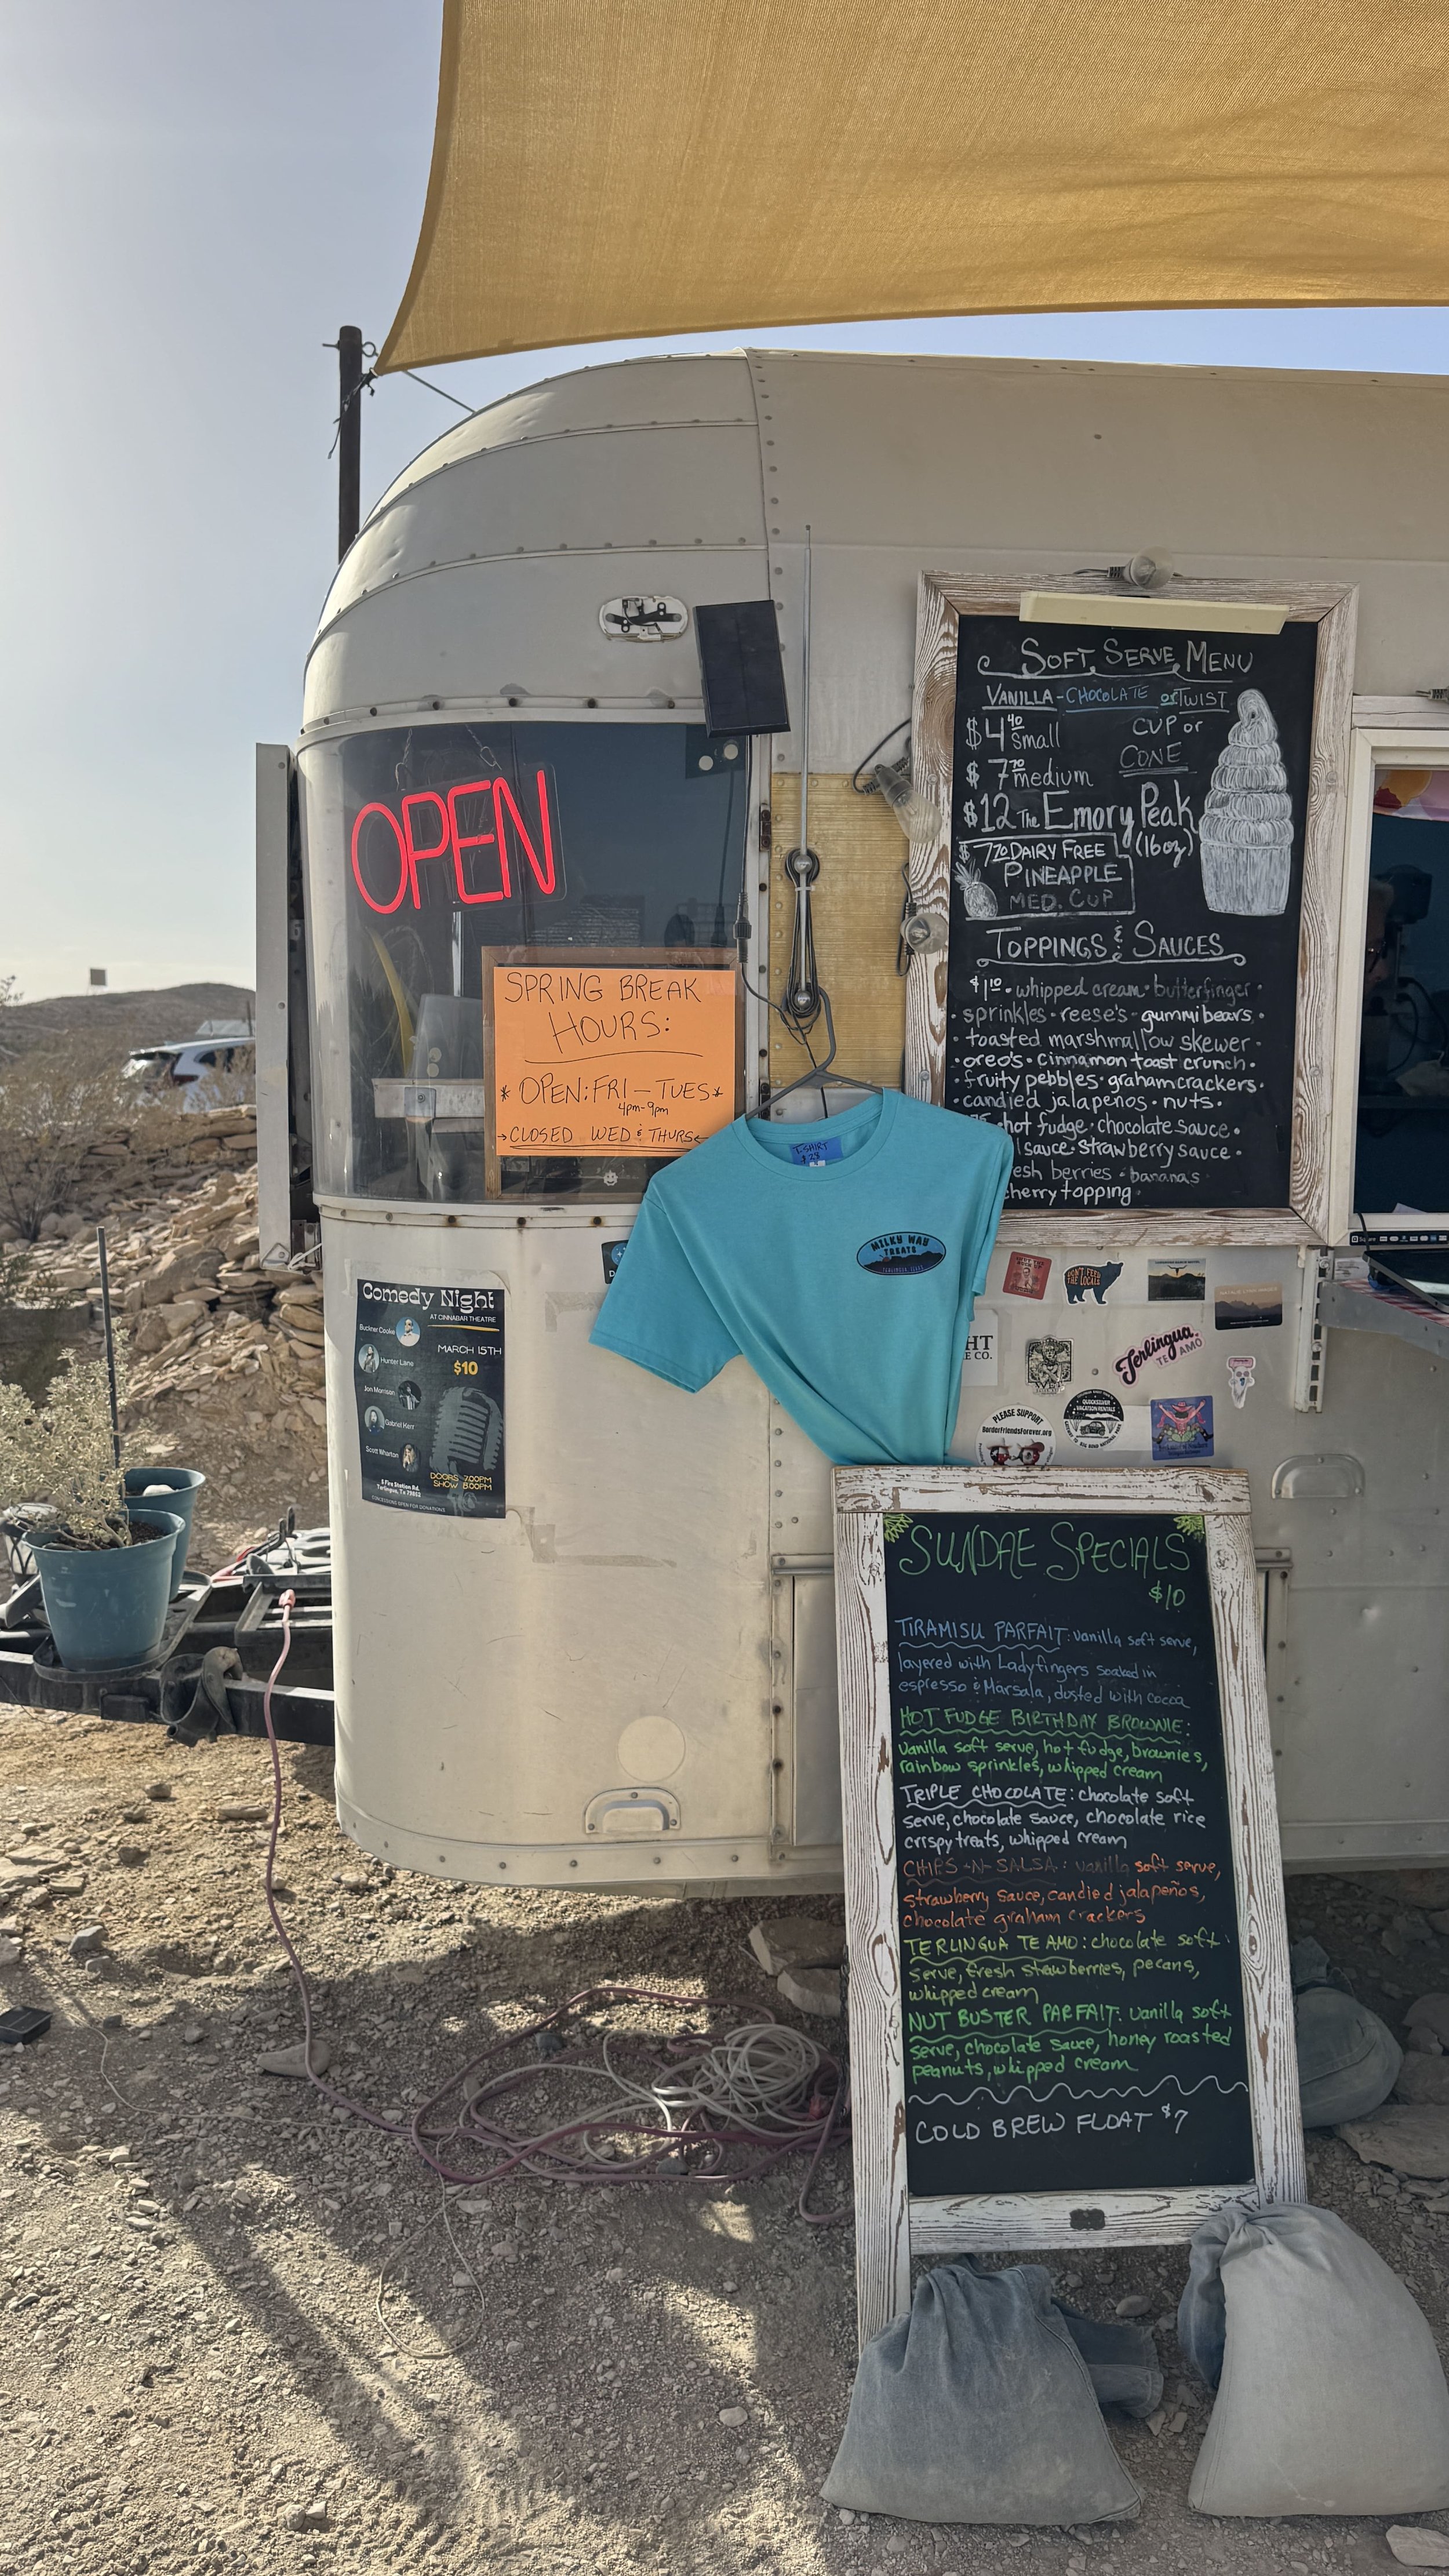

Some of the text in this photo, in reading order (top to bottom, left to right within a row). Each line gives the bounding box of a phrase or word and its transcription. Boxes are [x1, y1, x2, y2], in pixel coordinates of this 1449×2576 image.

[1022, 638, 1253, 675] SOFT SERVE MENU
[1013, 723, 1060, 749] small
[1133, 718, 1203, 736] CUP or
[1120, 742, 1182, 768] CONE
[1014, 758, 1093, 788] medium
[1017, 809, 1040, 828] The
[1043, 790, 1134, 848] Emory
[1141, 780, 1198, 835] Peak
[351, 769, 556, 915] OPEN
[1010, 842, 1106, 861] DAIRY FREE
[1005, 861, 1122, 888] PINEAPPLE
[1069, 888, 1113, 908] CUP
[986, 926, 1107, 959] TOPPINGS
[1133, 920, 1224, 957] SAUCES
[505, 972, 701, 1004] SPRING BREAK
[549, 1010, 669, 1054] HOURS:
[966, 1027, 1251, 1053] toasted marshmallow skewer
[1037, 1051, 1127, 1068] cinnamon
[1130, 1051, 1178, 1069] toast
[1184, 1055, 1246, 1071] crunch
[963, 1090, 1214, 1114] candied jalapenos nuts
[510, 1126, 573, 1143] CLOSED
[591, 1126, 631, 1142] WED
[649, 1127, 693, 1143] THURS
[793, 1141, 828, 1155] T-SHIRT
[871, 1235, 929, 1251] MILKY WAY
[884, 1246, 916, 1256] TREATS
[1067, 1268, 1101, 1279] DON'T FEED
[1067, 1276, 1100, 1286] THE LOCALS
[363, 1282, 494, 1314] Comedy Night
[438, 1314, 468, 1322] CINNABAR
[359, 1324, 395, 1335] Buckner Cooke
[438, 1344, 502, 1355] MARCH 15TH
[974, 1351, 992, 1360] CO.
[1116, 1327, 1193, 1384] Terlingua
[1180, 1338, 1202, 1355] AMO
[399, 1359, 414, 1367] Lane
[454, 1360, 478, 1376] $10
[1156, 1355, 1168, 1366] TE
[374, 1387, 395, 1396] Morrison
[385, 1419, 415, 1431] Gabriel Kerr
[992, 1409, 1044, 1425] PLEASE SUPPORT
[982, 1426, 1052, 1436] BorderFriendsForever.org
[366, 1446, 399, 1458] Scott Wharton
[430, 1472, 459, 1482] DOORS
[434, 1480, 458, 1488] SHOW
[419, 1505, 446, 1513] DONATIONS
[899, 1521, 1190, 1581] SUNDAE SPECIALS
[1149, 1580, 1186, 1609] $10
[895, 1617, 1197, 1656] TIRAMISU PARFAIT: vanilla soft serve,
[898, 1651, 1157, 1682] layered with Ladyfingers soaked in
[900, 1706, 1190, 1737] HOT FUDGE BIRTHDAY BROWNIE:
[900, 1756, 1163, 1783] rainbow sprinkles, whipped cream
[903, 1887, 989, 1913] strawberry
[997, 1889, 1044, 1906] sauce,
[1047, 1880, 1113, 1901] candied
[909, 1999, 1232, 2032] NUT BUSTER PARFAIT: vanilla soft
[916, 2104, 1188, 2144] COLD BREW FLOAT $7
